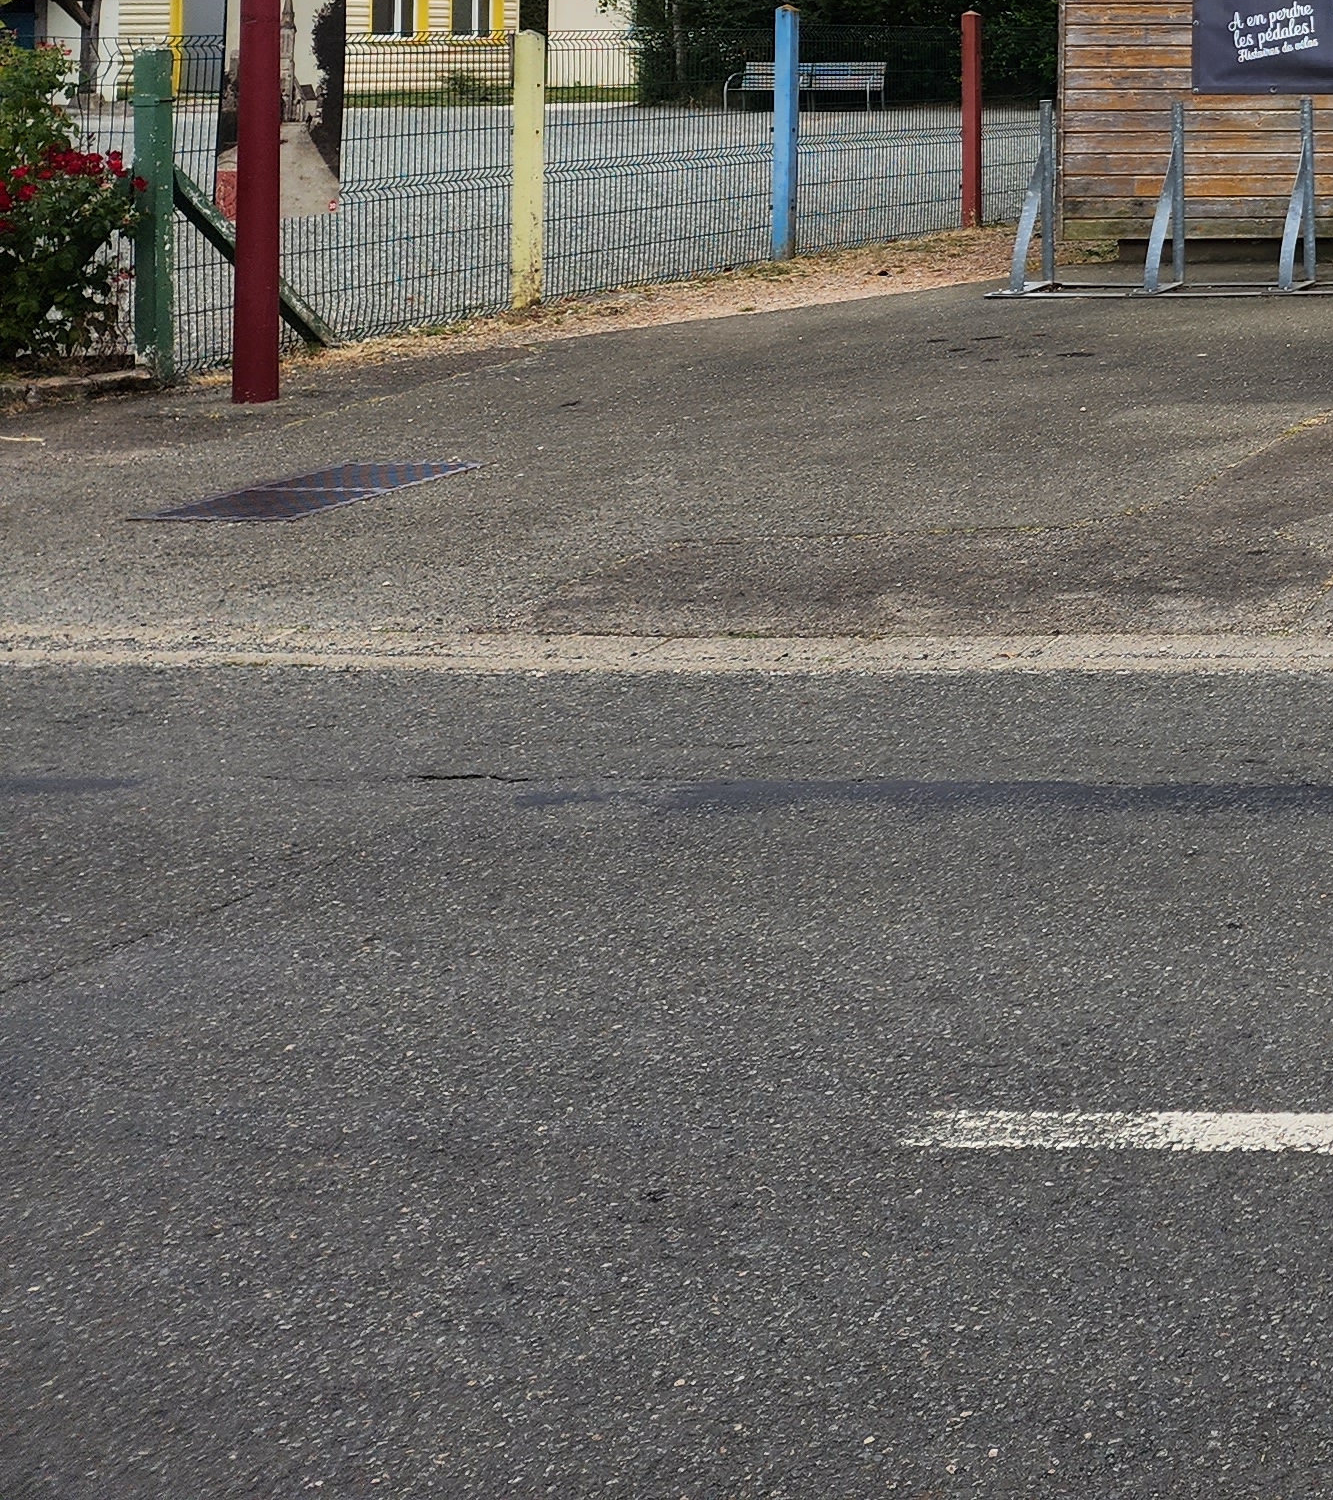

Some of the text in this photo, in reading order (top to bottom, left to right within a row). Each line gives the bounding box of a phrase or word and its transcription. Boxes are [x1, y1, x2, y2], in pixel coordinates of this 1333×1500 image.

[1227, 0, 1314, 32] A en perdre
[1233, 30, 1254, 48] les
